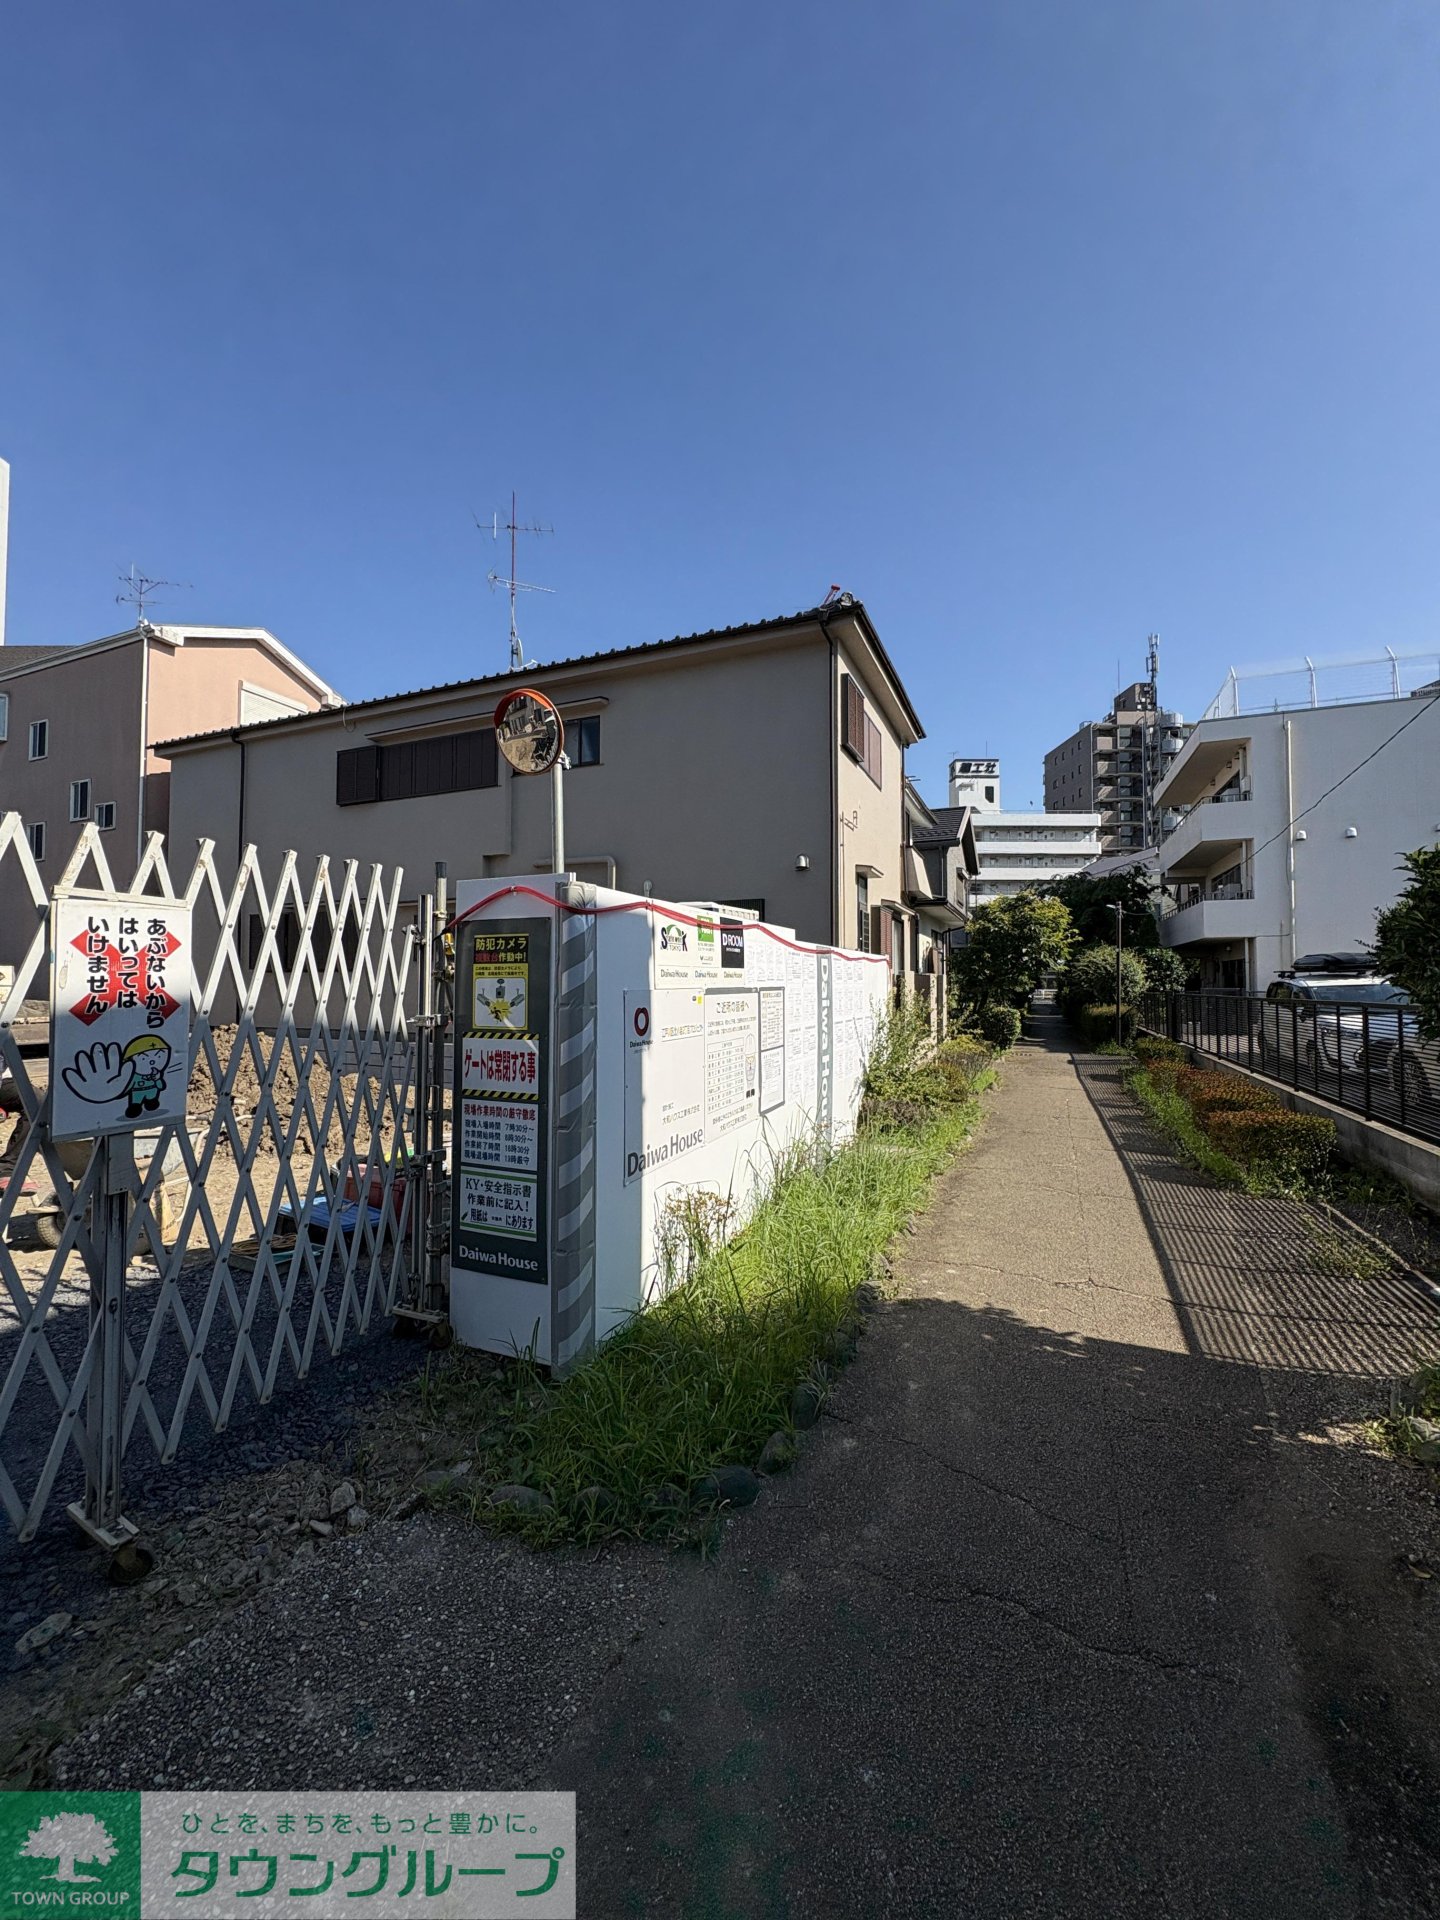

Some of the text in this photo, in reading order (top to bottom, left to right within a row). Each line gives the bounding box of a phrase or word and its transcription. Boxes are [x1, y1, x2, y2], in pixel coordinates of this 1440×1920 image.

[476, 937, 527, 950] 防犯カメラ
[86, 916, 110, 1014] いけません
[117, 917, 139, 1008] はいっては
[145, 918, 166, 1028] あぶないから
[661, 969, 675, 978] Daiwa
[695, 969, 706, 978] Daiwa
[464, 1049, 536, 1084] ゲートは常閉する事
[464, 1104, 536, 1120] 現場作業時間の厳守徹底
[465, 1119, 501, 1131] 現場入場時間
[465, 1130, 501, 1141] 作業開始時間
[465, 1141, 501, 1152] 作業終了時間
[627, 1128, 703, 1178] Daiwa House
[465, 1177, 532, 1198] KY・安全指示書
[467, 1193, 529, 1212] 作業前に記入！
[470, 1208, 488, 1222] 用紙は
[505, 1213, 534, 1229] にあります
[459, 1245, 538, 1271] Daiwa House
